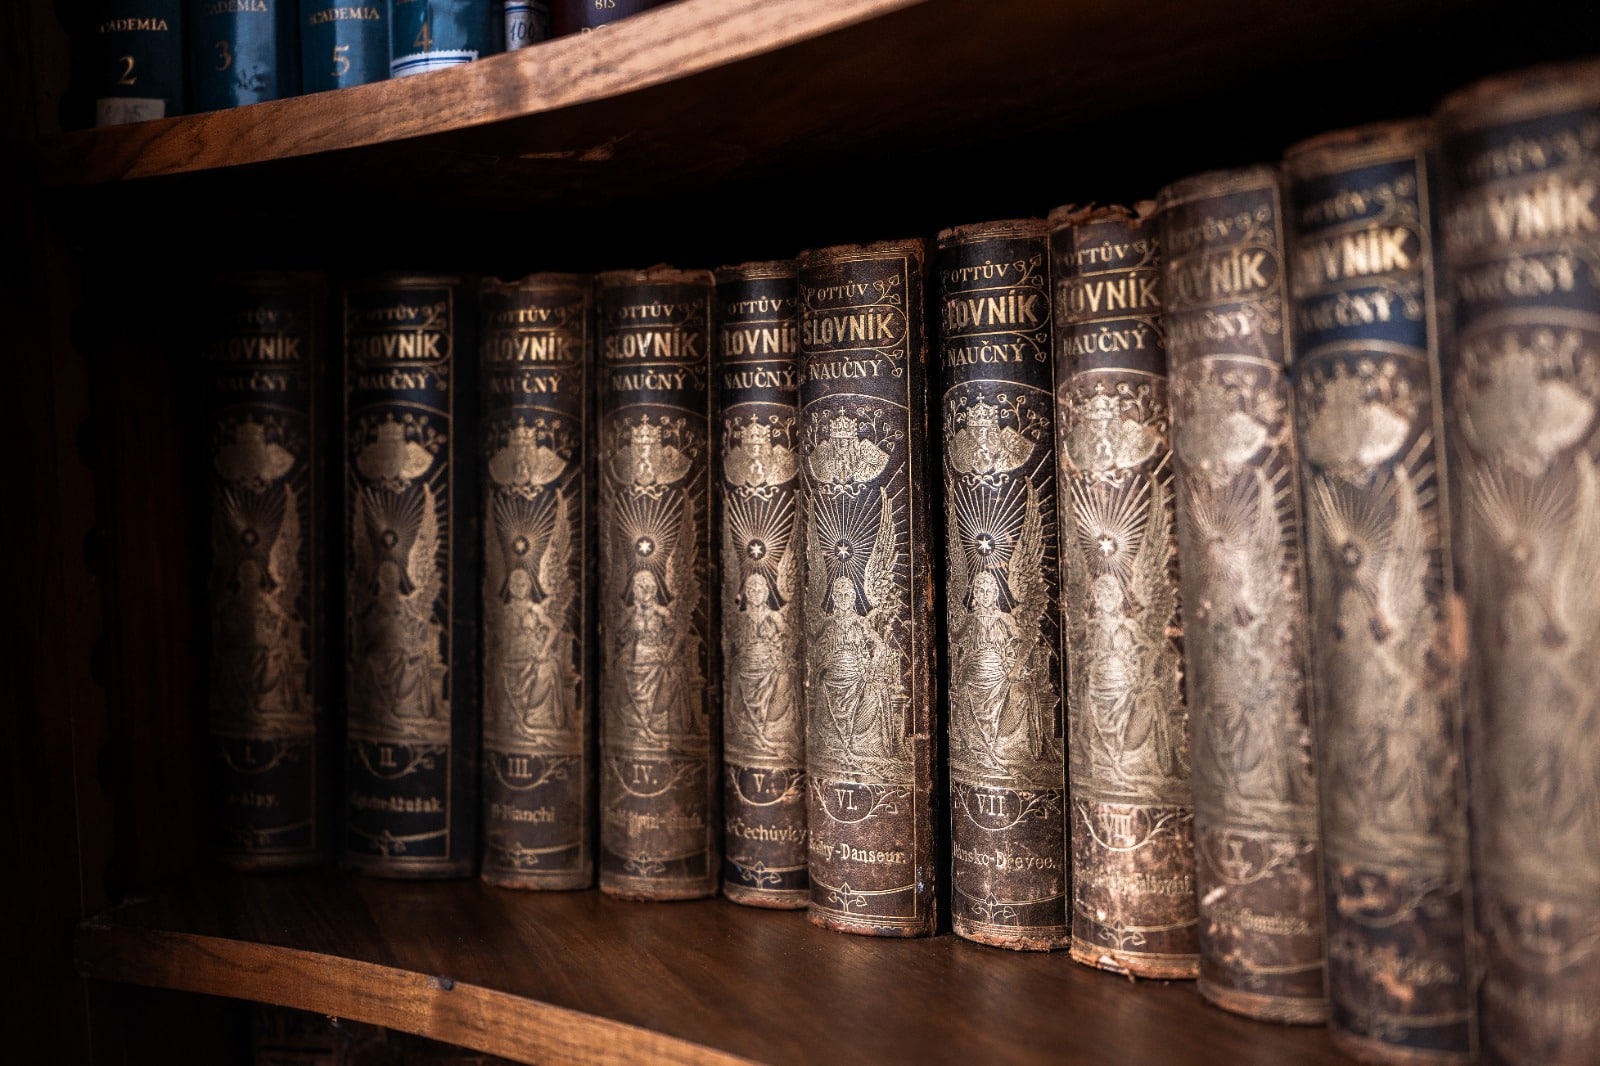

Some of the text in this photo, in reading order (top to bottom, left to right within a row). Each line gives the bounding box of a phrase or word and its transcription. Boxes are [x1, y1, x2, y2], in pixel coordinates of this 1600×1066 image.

[414, 21, 433, 51] 4
[116, 55, 137, 87] 2
[214, 41, 232, 72] 3
[330, 45, 350, 77] 5
[951, 260, 1010, 284] OTTŮV
[803, 308, 896, 345] SLOVNÍK
[605, 327, 699, 359] SLOVNÍK
[947, 338, 1027, 368] NAUČNÝ
[613, 369, 687, 391] NAUČNÝ
[809, 356, 883, 381] NAUČNÝ
